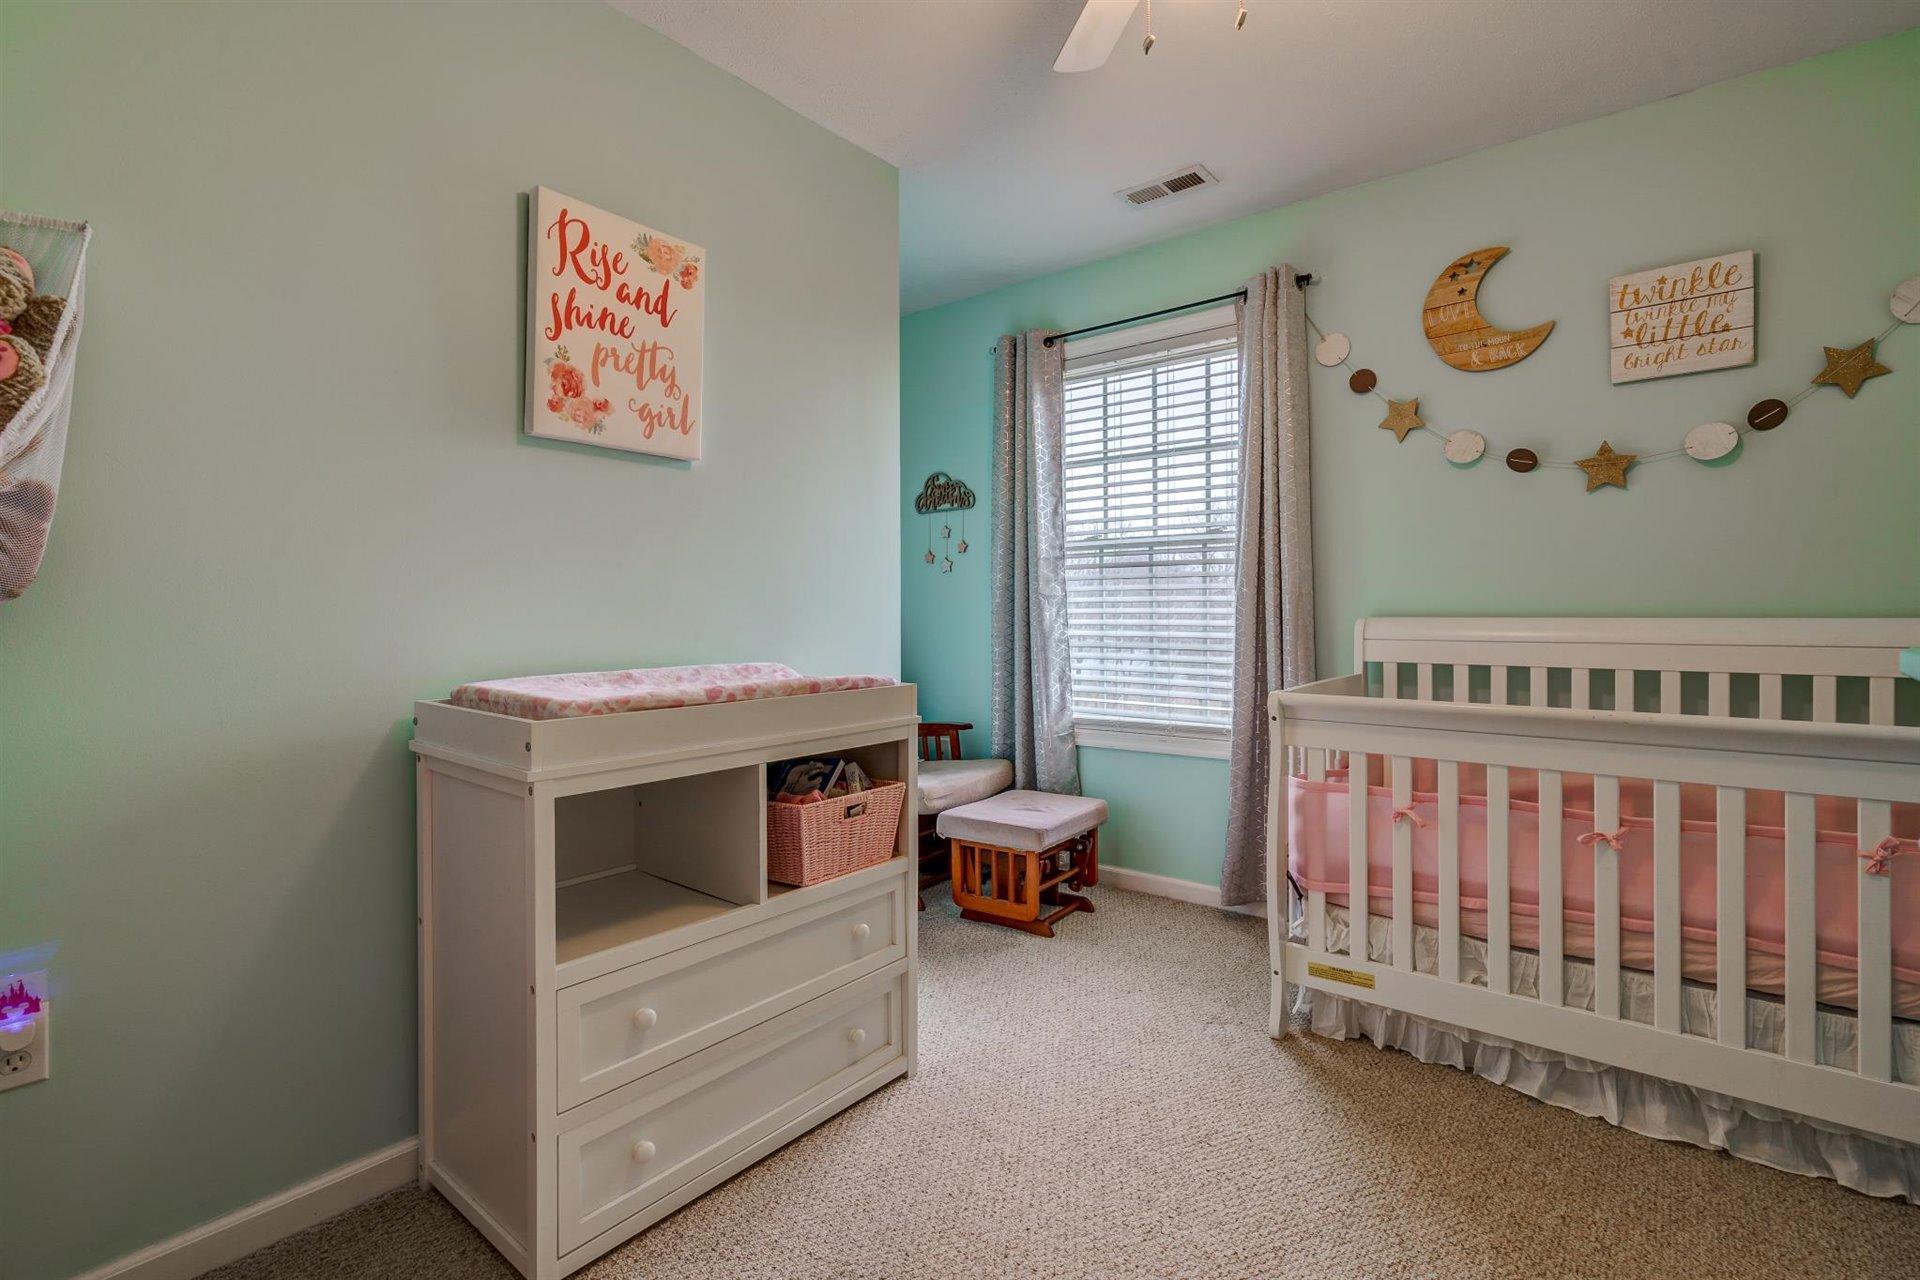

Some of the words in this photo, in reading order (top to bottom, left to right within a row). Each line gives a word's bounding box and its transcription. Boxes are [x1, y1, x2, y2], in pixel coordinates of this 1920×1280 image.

[547, 208, 628, 290] Rise
[616, 279, 677, 328] and
[1615, 261, 1743, 310] twinkle
[1426, 301, 1475, 326] LOVE
[1625, 298, 1698, 326] twinkle
[1706, 291, 1738, 313] my
[1635, 310, 1726, 349] little
[591, 340, 681, 400] pretty
[1488, 342, 1528, 362] BACK
[1623, 343, 1688, 372] bright
[1696, 337, 1746, 357] star
[629, 394, 696, 439] girl
